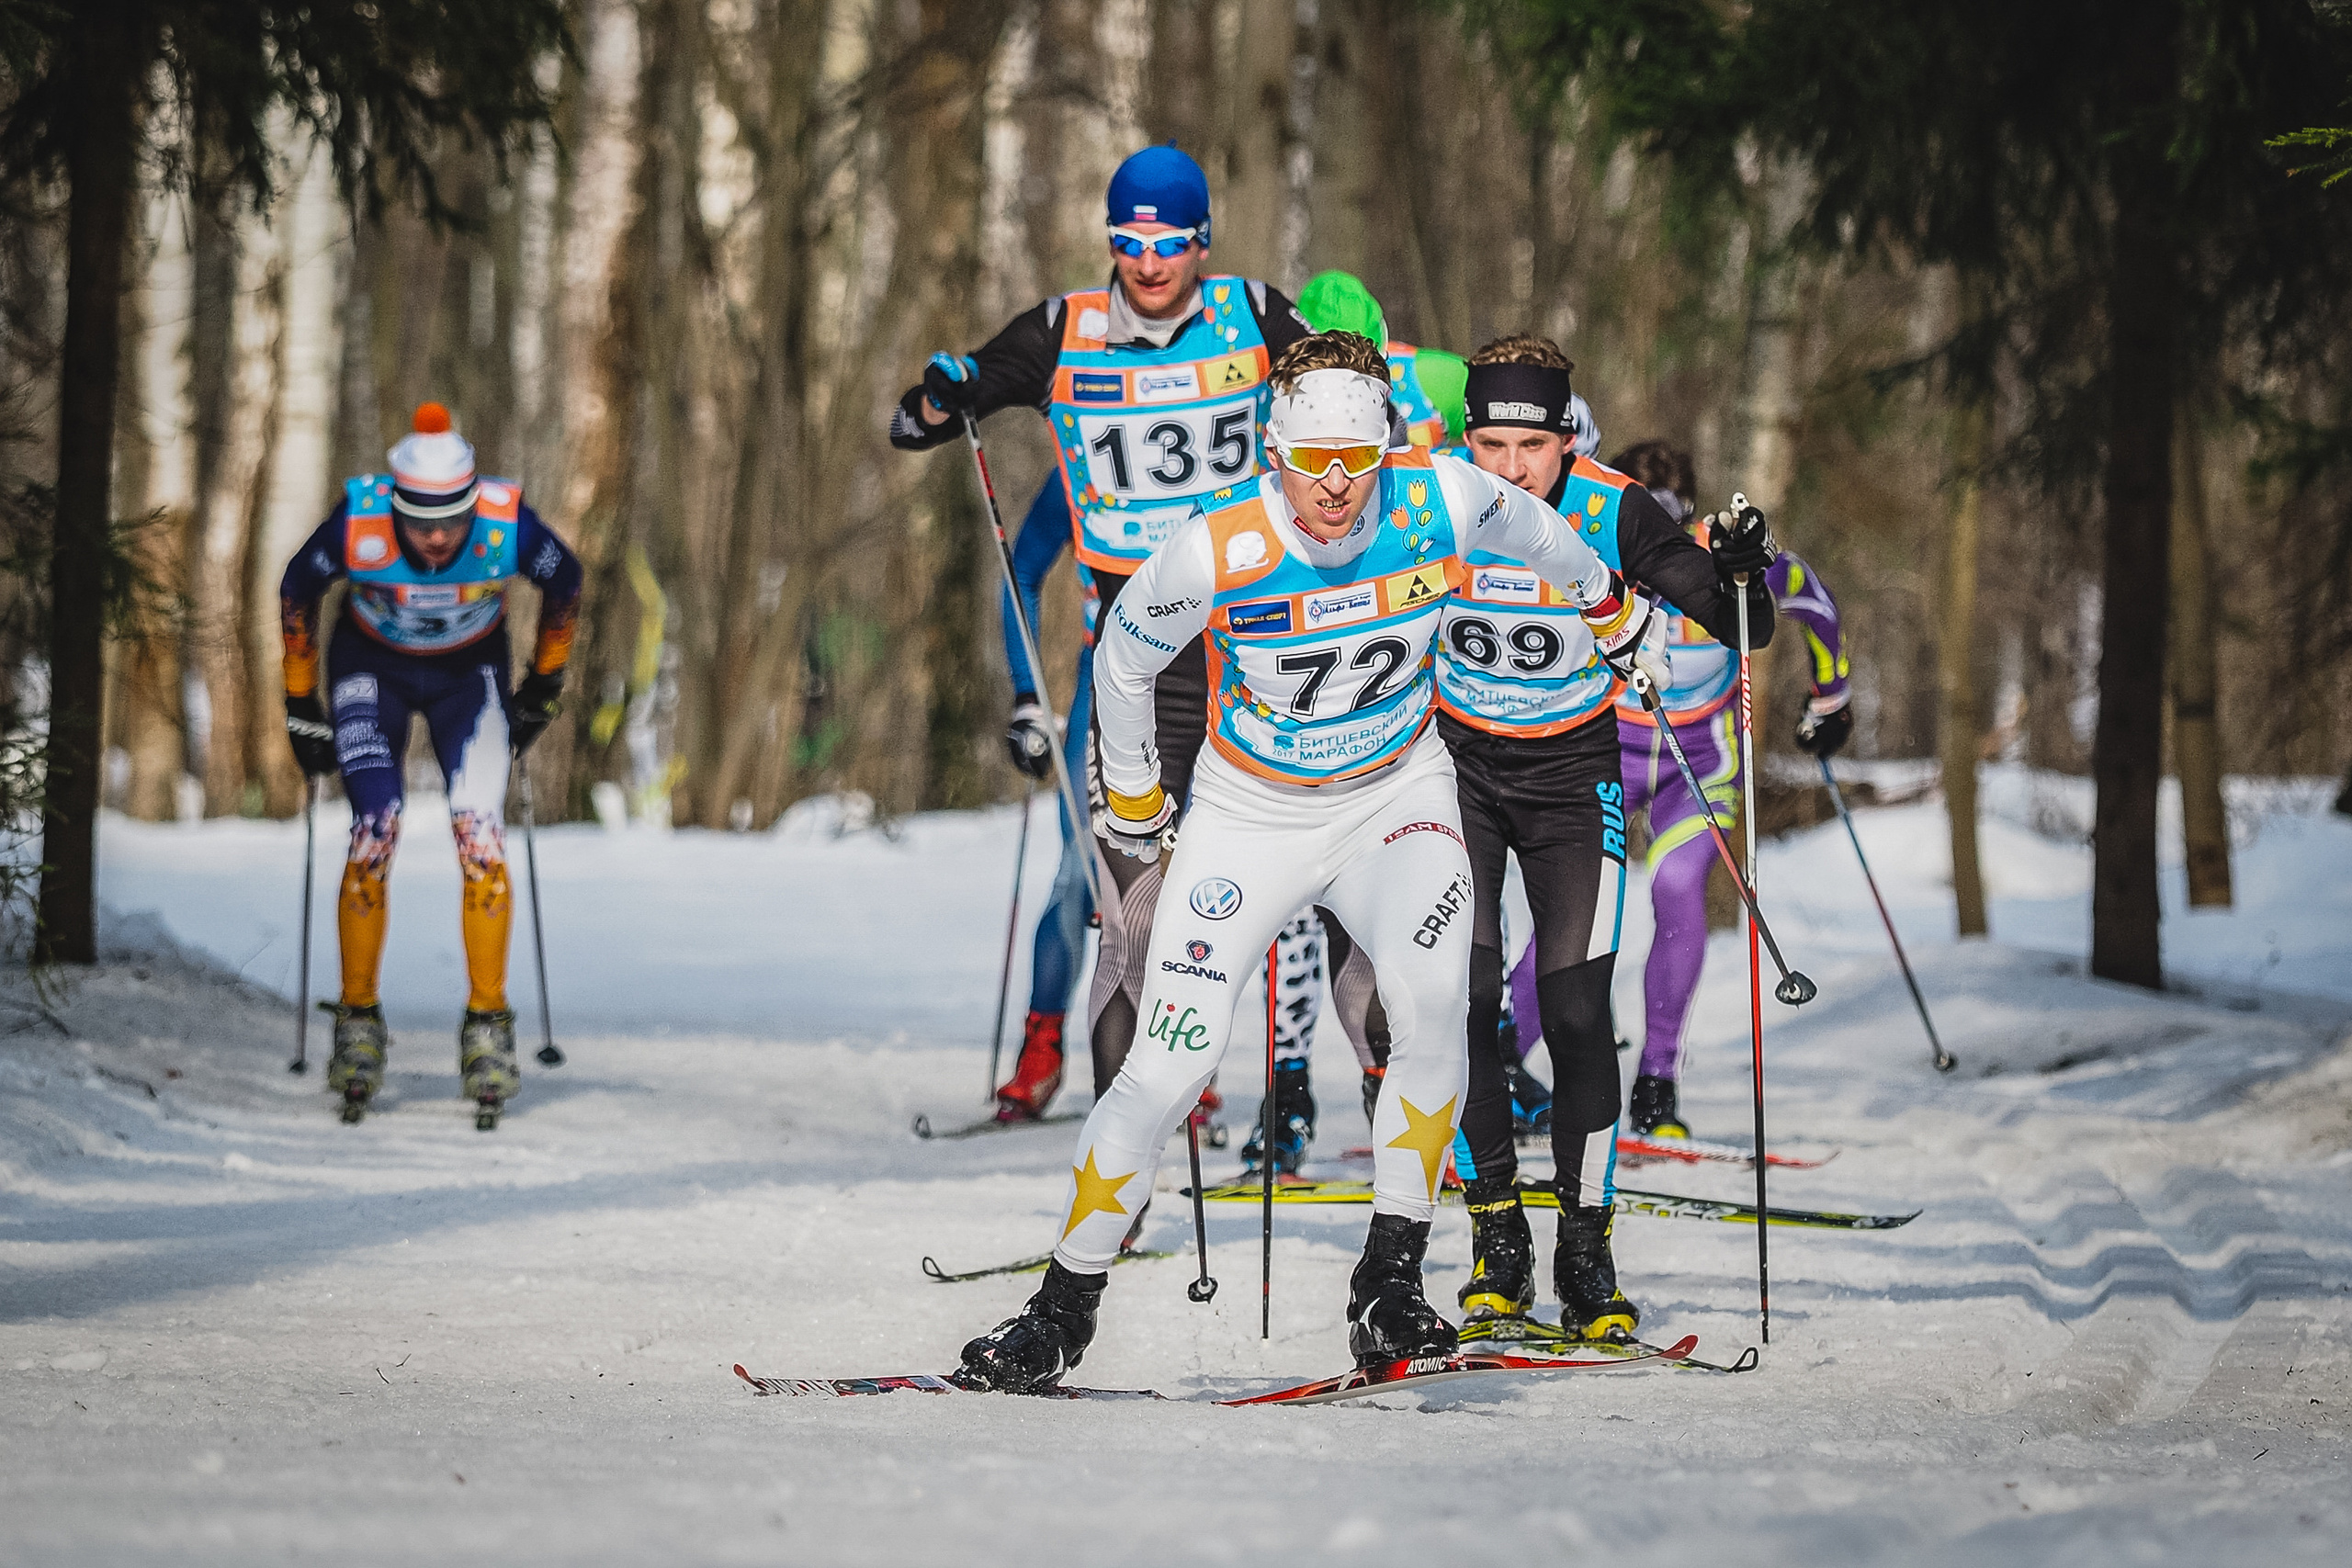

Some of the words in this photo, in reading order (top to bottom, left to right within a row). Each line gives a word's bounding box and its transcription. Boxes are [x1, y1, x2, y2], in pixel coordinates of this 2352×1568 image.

[1091, 406, 1252, 493] 135
[1114, 604, 1178, 653] Folksam
[1147, 600, 1188, 618] CRAFT
[1446, 616, 1565, 674] 69
[1276, 635, 1411, 716] 72
[1299, 705, 1408, 749] БИТЦЕВСКИЙ
[1299, 734, 1386, 761] МАРАФОН
[1272, 749, 1294, 758] 2017
[1385, 822, 1433, 841] TEAM
[1596, 781, 1625, 860] RUS
[1412, 880, 1467, 950] CRAFT
[1161, 961, 1227, 984] SCANIA
[1148, 998, 1210, 1052] life
[1405, 1355, 1448, 1375] ATOMIC
